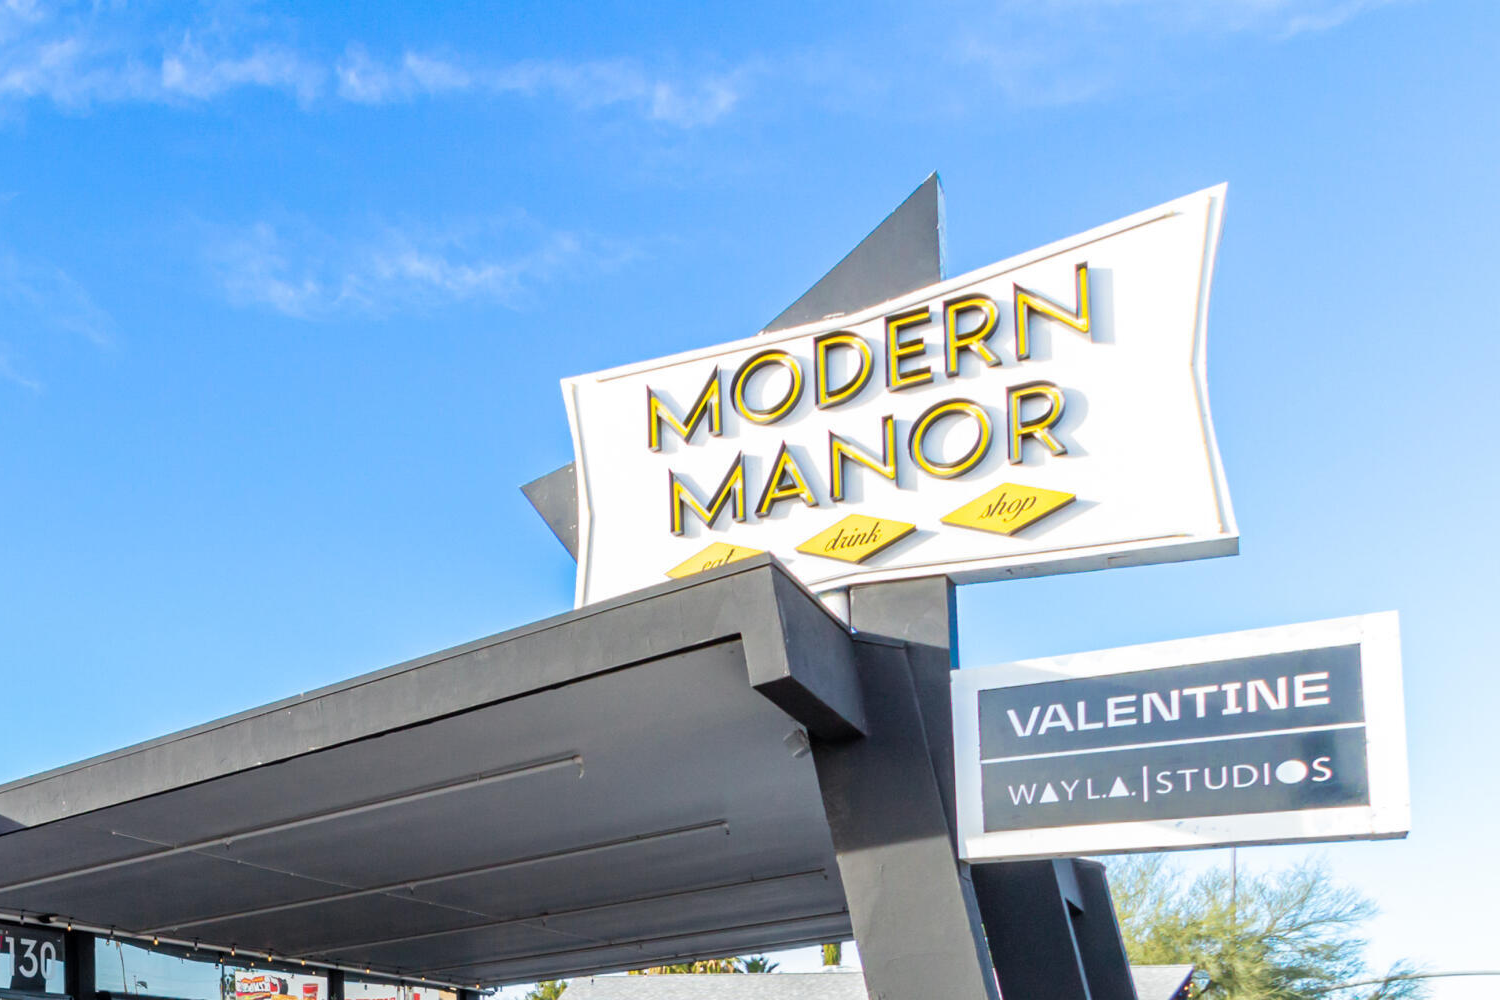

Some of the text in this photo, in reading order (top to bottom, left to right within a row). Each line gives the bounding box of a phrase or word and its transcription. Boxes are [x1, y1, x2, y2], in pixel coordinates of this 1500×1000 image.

[647, 262, 1091, 452] MODERN
[668, 380, 1069, 536] MANOR
[978, 491, 1038, 523] shop
[824, 520, 882, 553] drink
[1007, 671, 1331, 737] VALENTINE
[1155, 757, 1333, 795] STUDIOS
